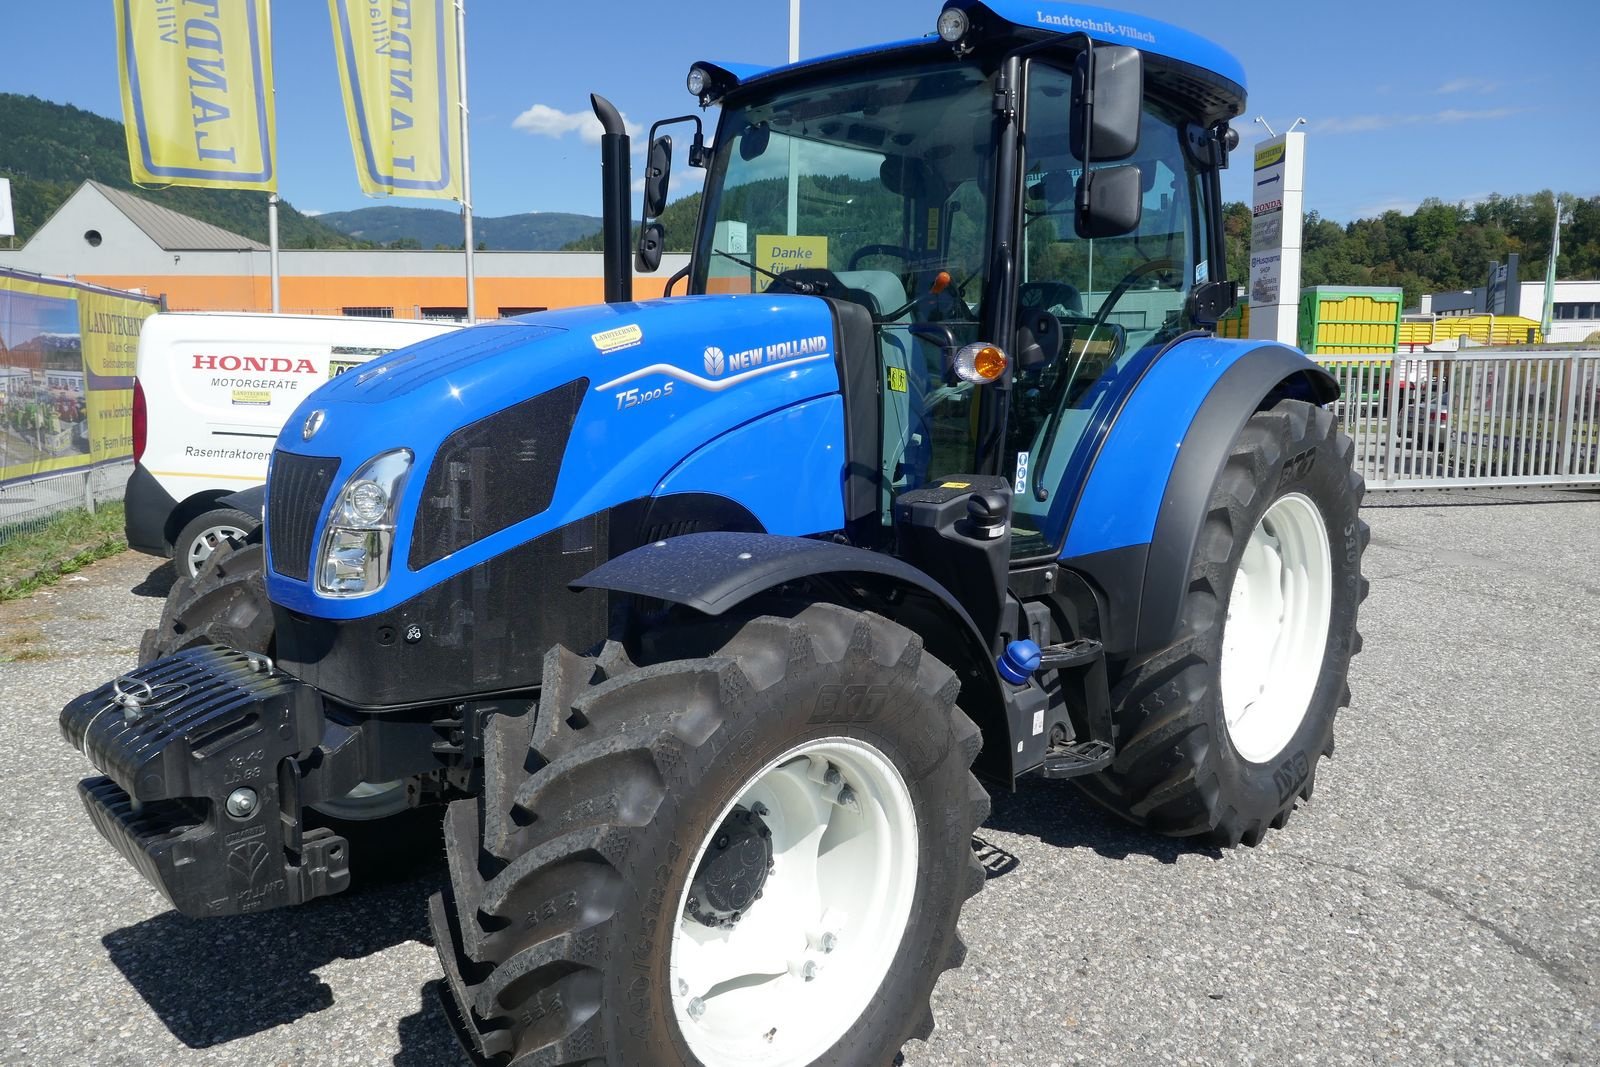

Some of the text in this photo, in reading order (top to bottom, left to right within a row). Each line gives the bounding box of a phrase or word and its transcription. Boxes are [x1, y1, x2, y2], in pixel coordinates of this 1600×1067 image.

[1037, 11, 1156, 43] Landtechnik-Villach
[1254, 200, 1282, 213] HONDA
[771, 246, 813, 259] Danke
[729, 335, 827, 372] NEW HOLLAND
[192, 355, 318, 374] HONDA
[211, 377, 298, 390] MOTORGERÄTE
